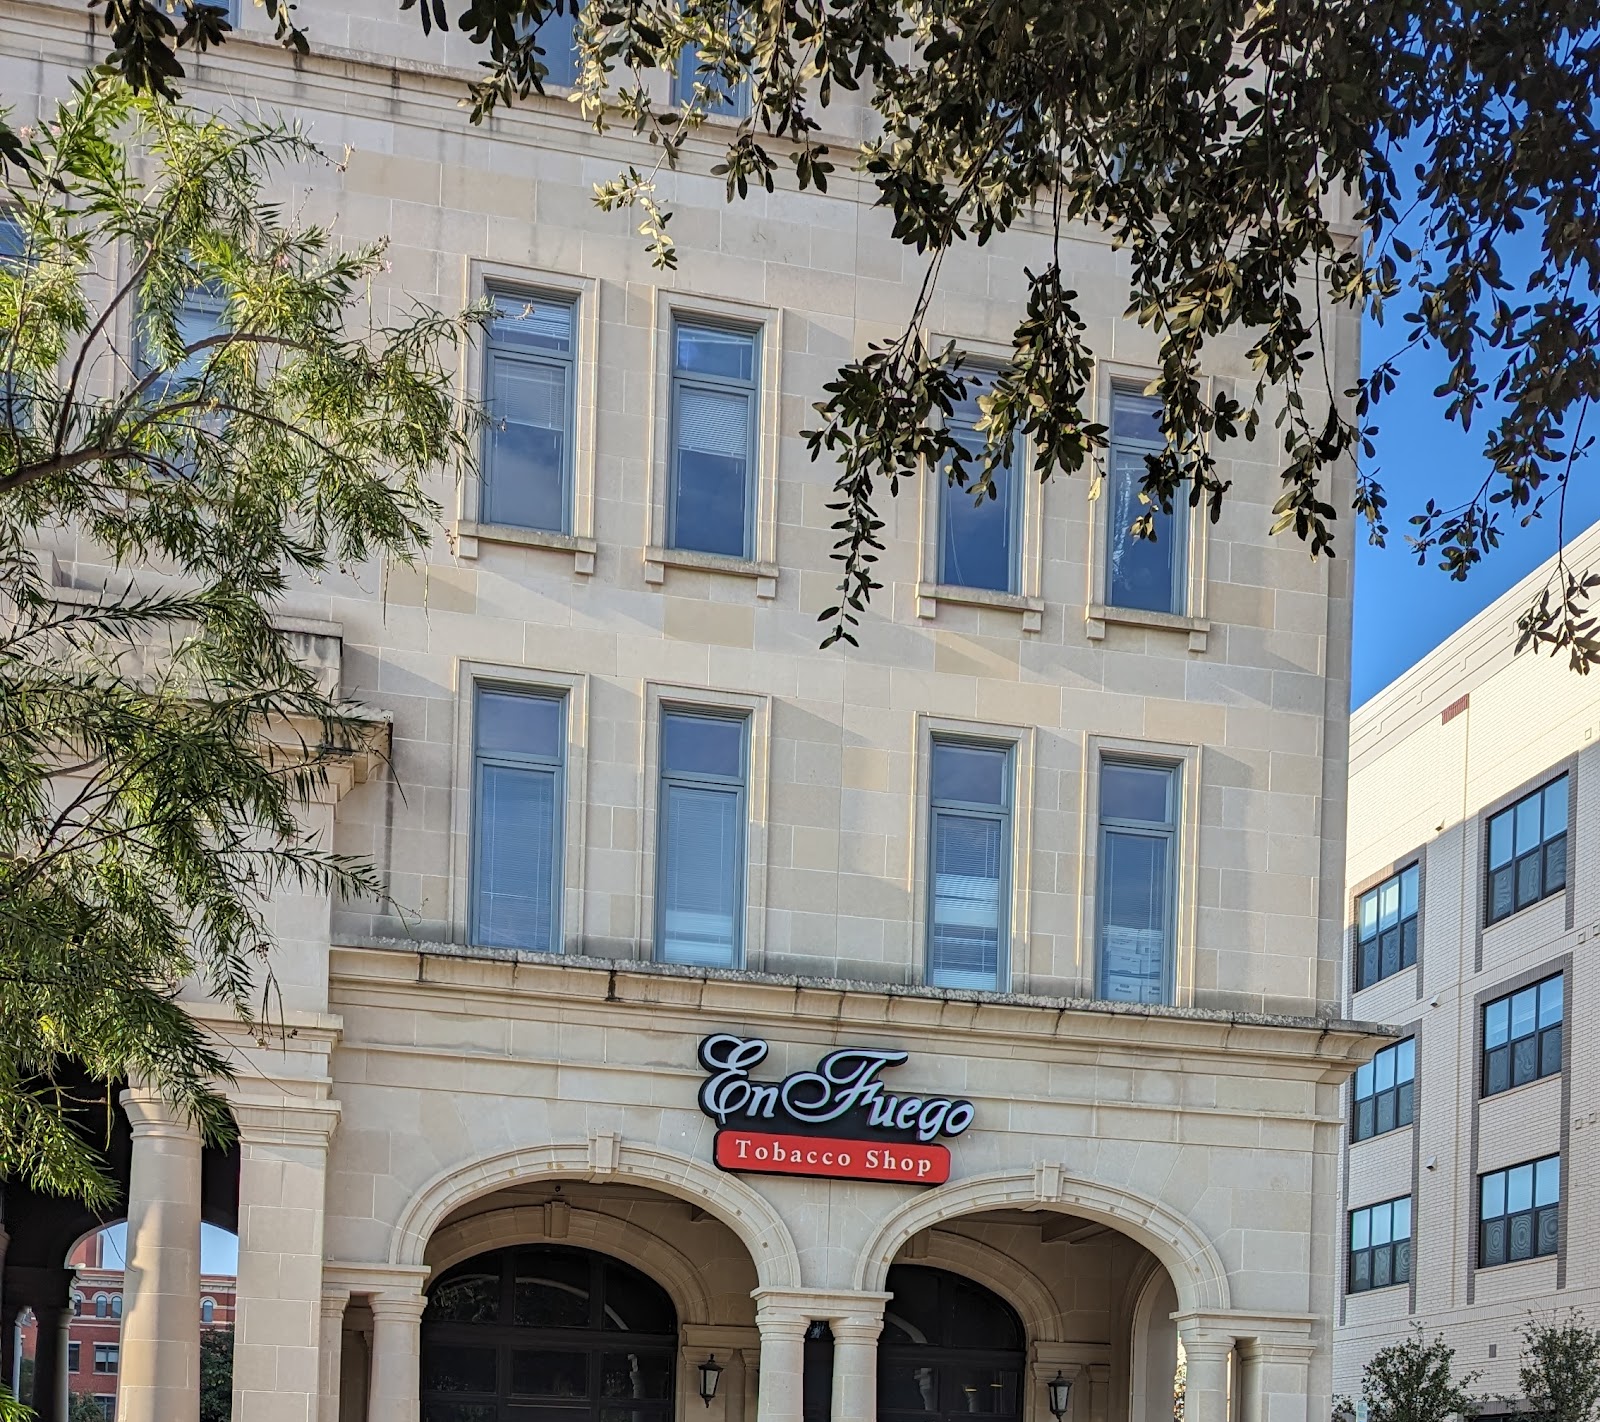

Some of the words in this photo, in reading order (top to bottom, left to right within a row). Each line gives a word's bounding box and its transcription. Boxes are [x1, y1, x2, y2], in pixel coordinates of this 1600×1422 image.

[702, 1034, 779, 1124] En
[782, 1050, 975, 1141] Fuego
[735, 1139, 851, 1167] Tobacco
[865, 1149, 932, 1177] Shop
